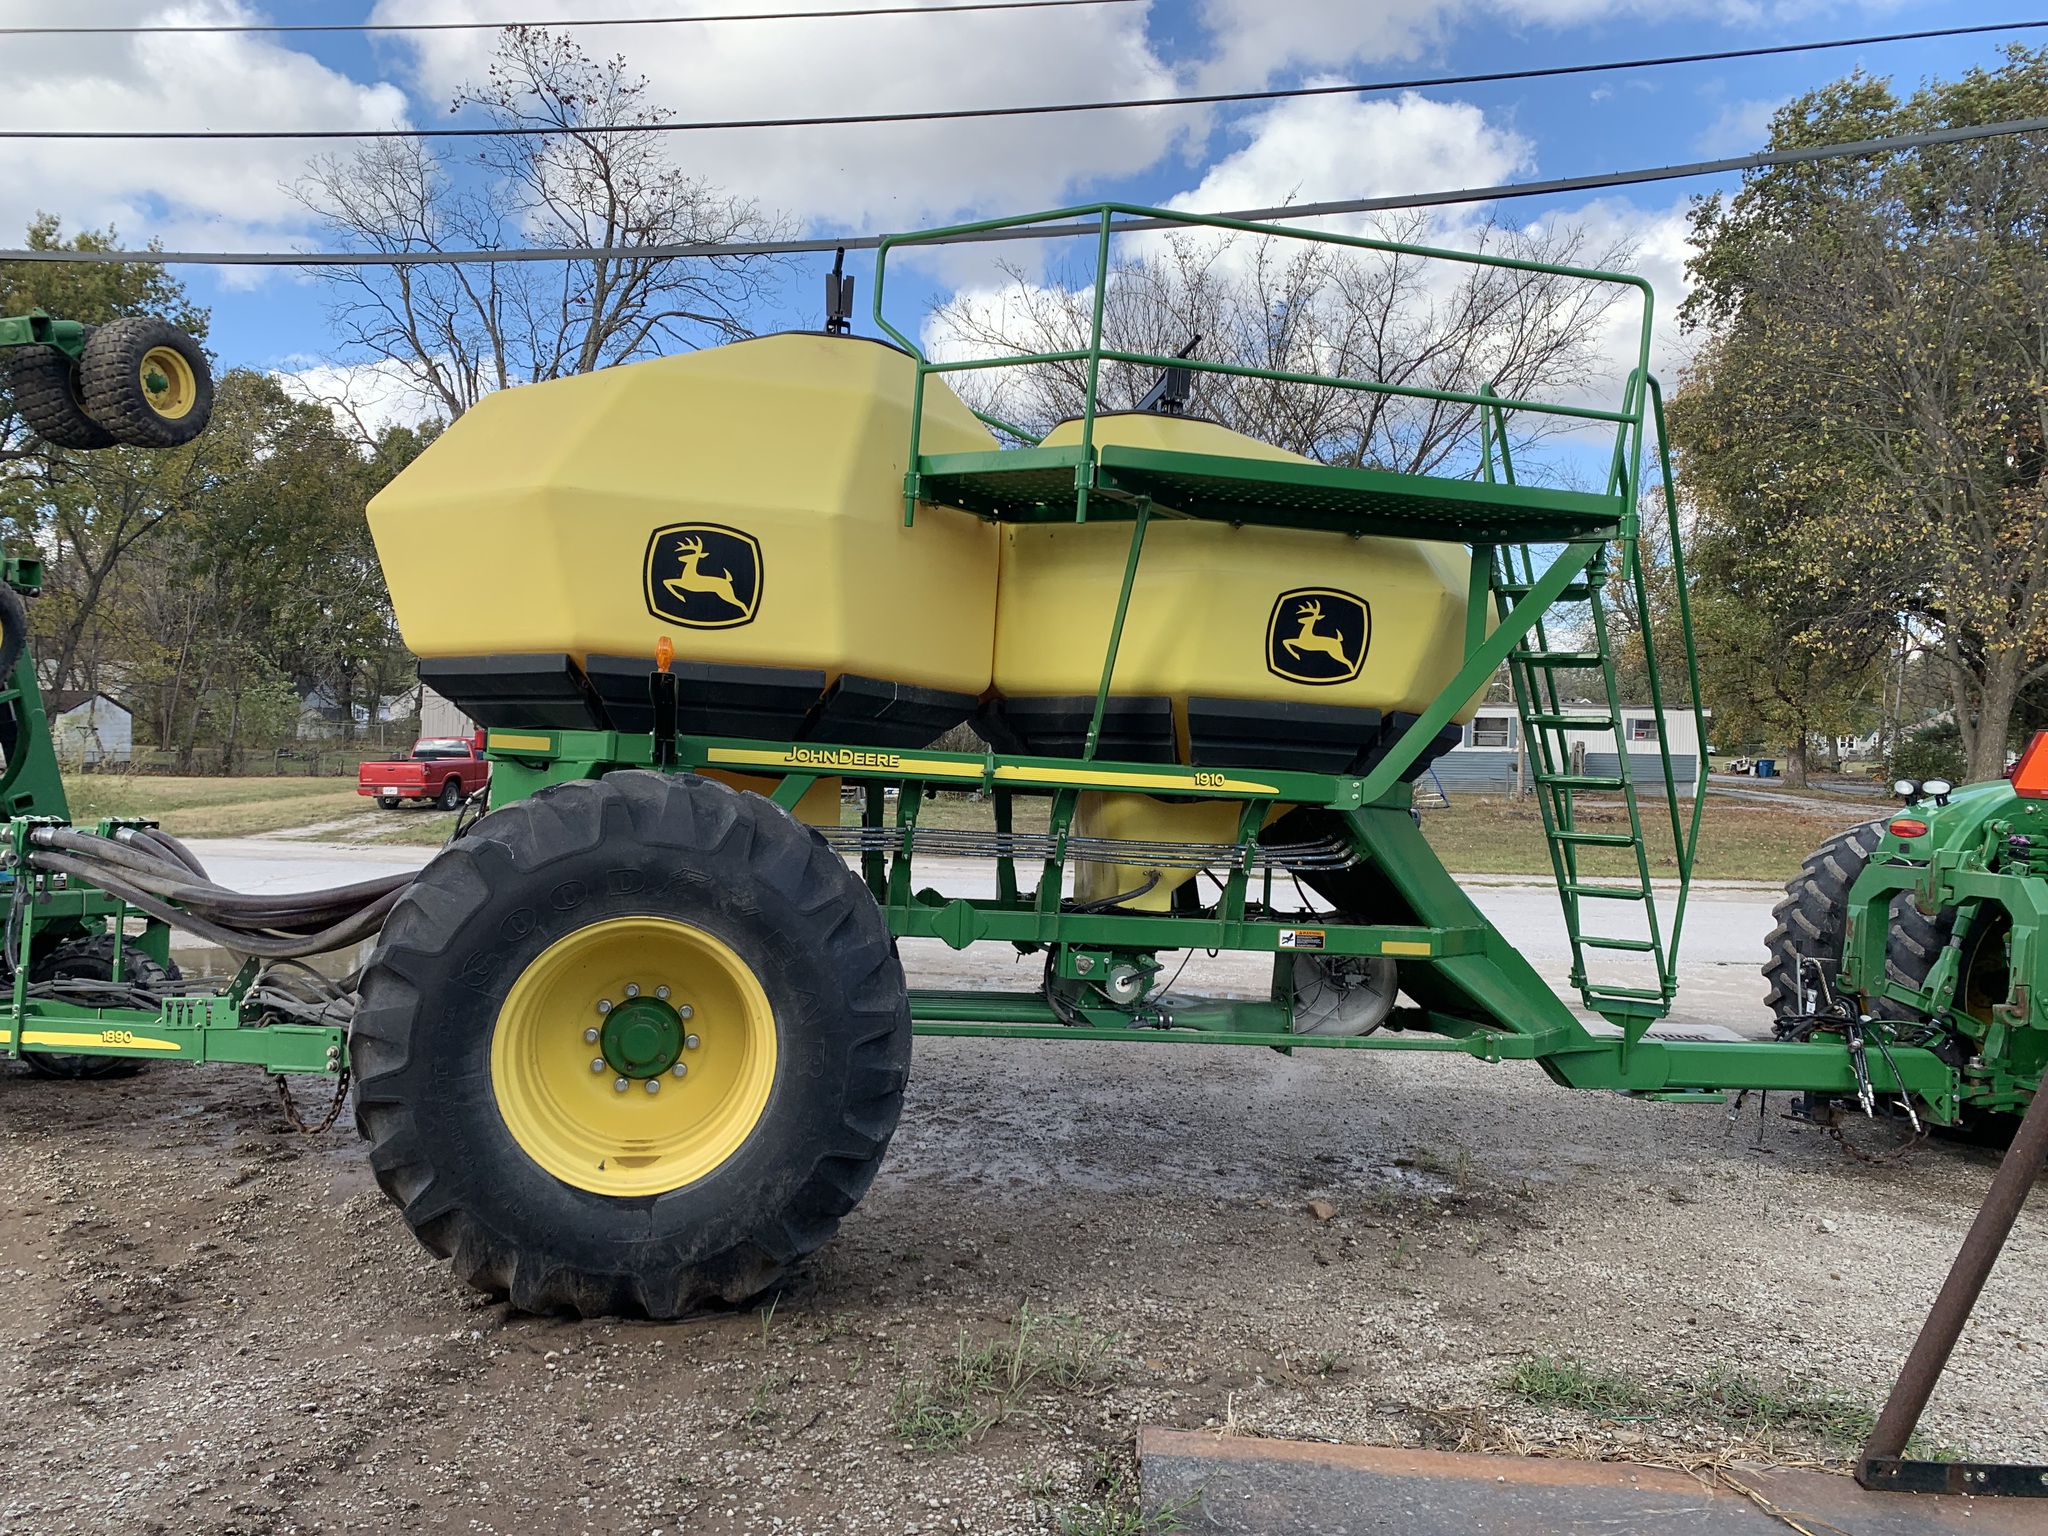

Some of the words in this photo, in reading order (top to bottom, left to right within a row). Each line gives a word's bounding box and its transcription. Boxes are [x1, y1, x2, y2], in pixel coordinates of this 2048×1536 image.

[785, 746, 837, 764] JOHN
[839, 749, 900, 768] DEERE
[1194, 772, 1225, 787] 1910
[101, 1030, 133, 1044] 1890
